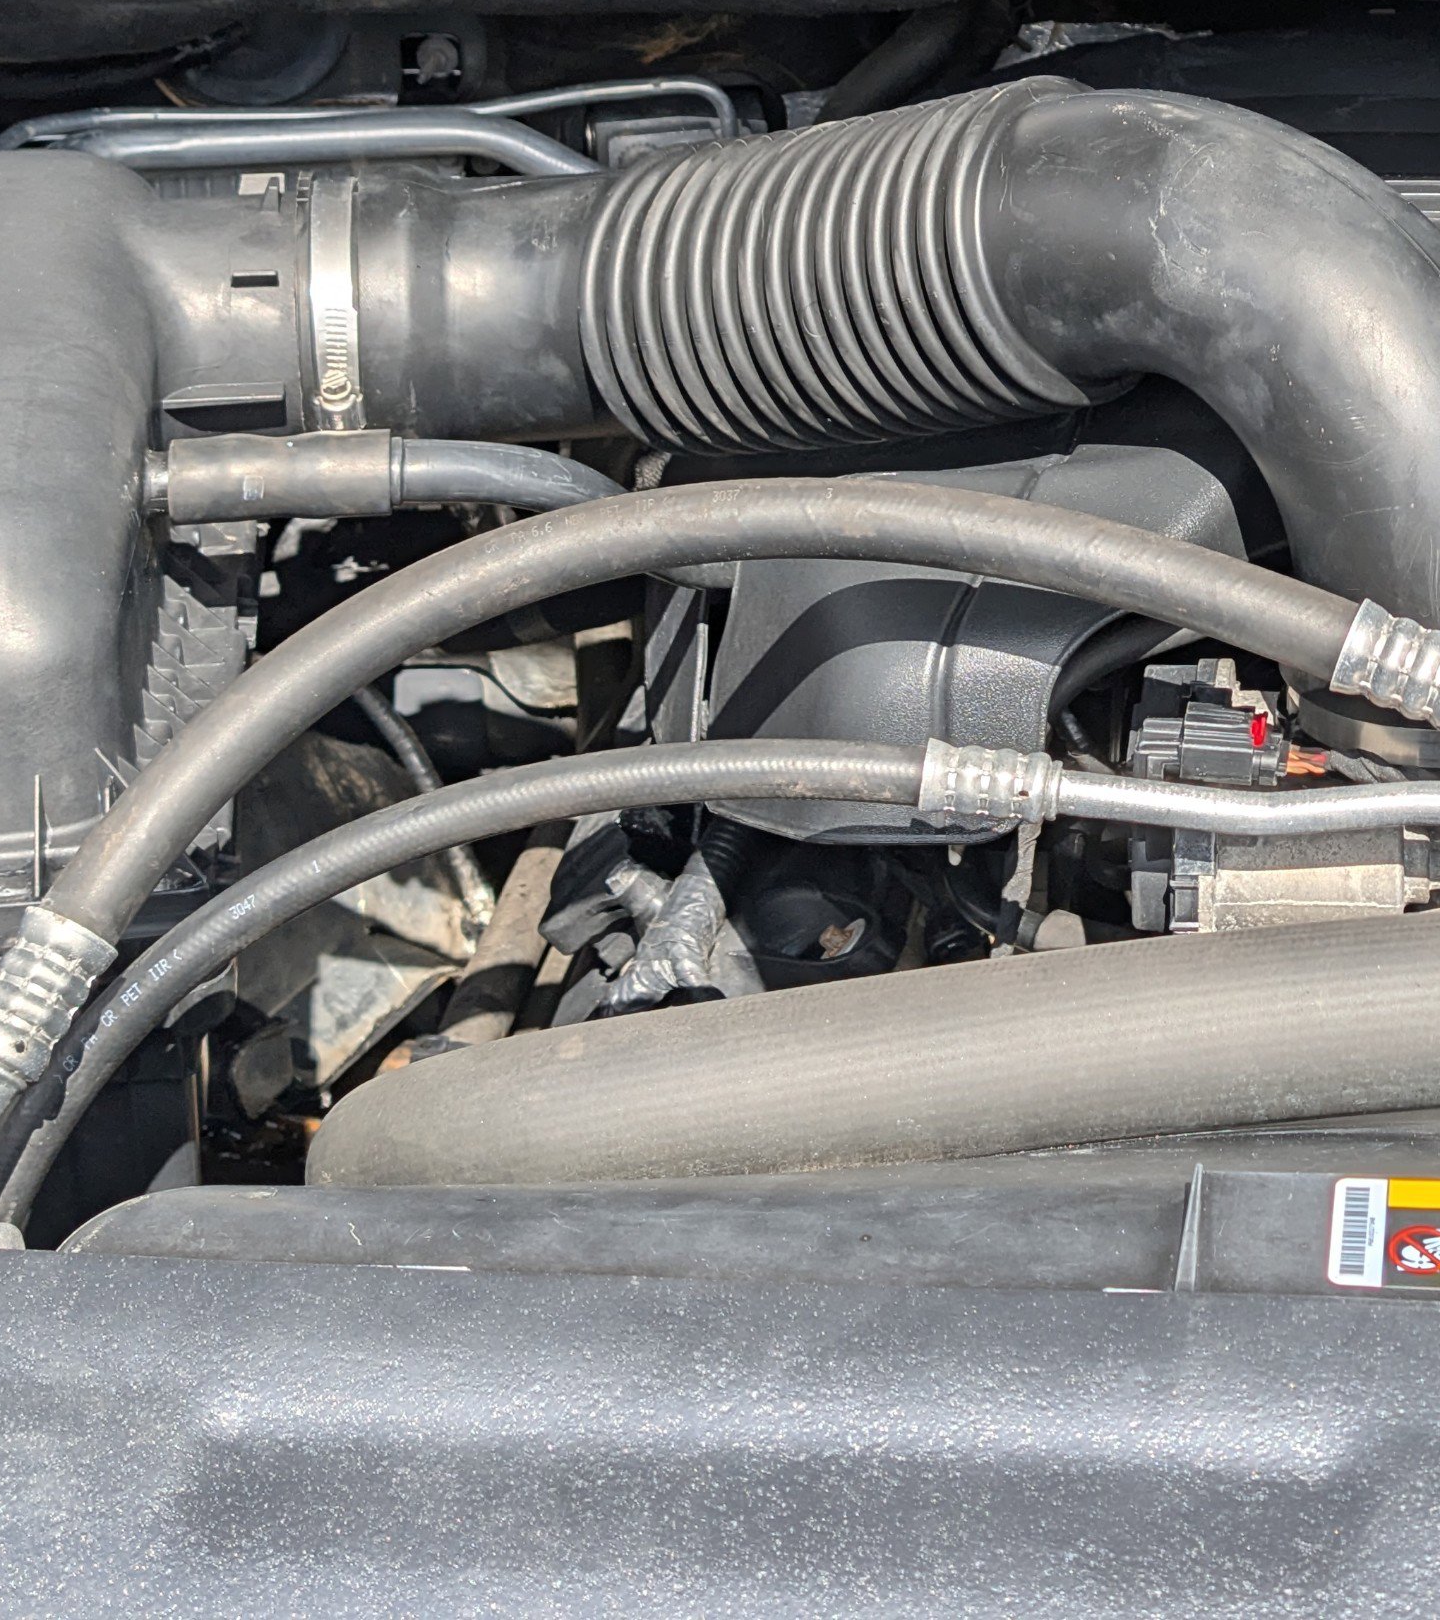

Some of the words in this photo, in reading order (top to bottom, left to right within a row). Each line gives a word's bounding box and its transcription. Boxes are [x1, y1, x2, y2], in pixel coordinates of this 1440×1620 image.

[100, 1009, 118, 1027] CR
[120, 982, 144, 1007] PET
[228, 894, 257, 920] 3047
